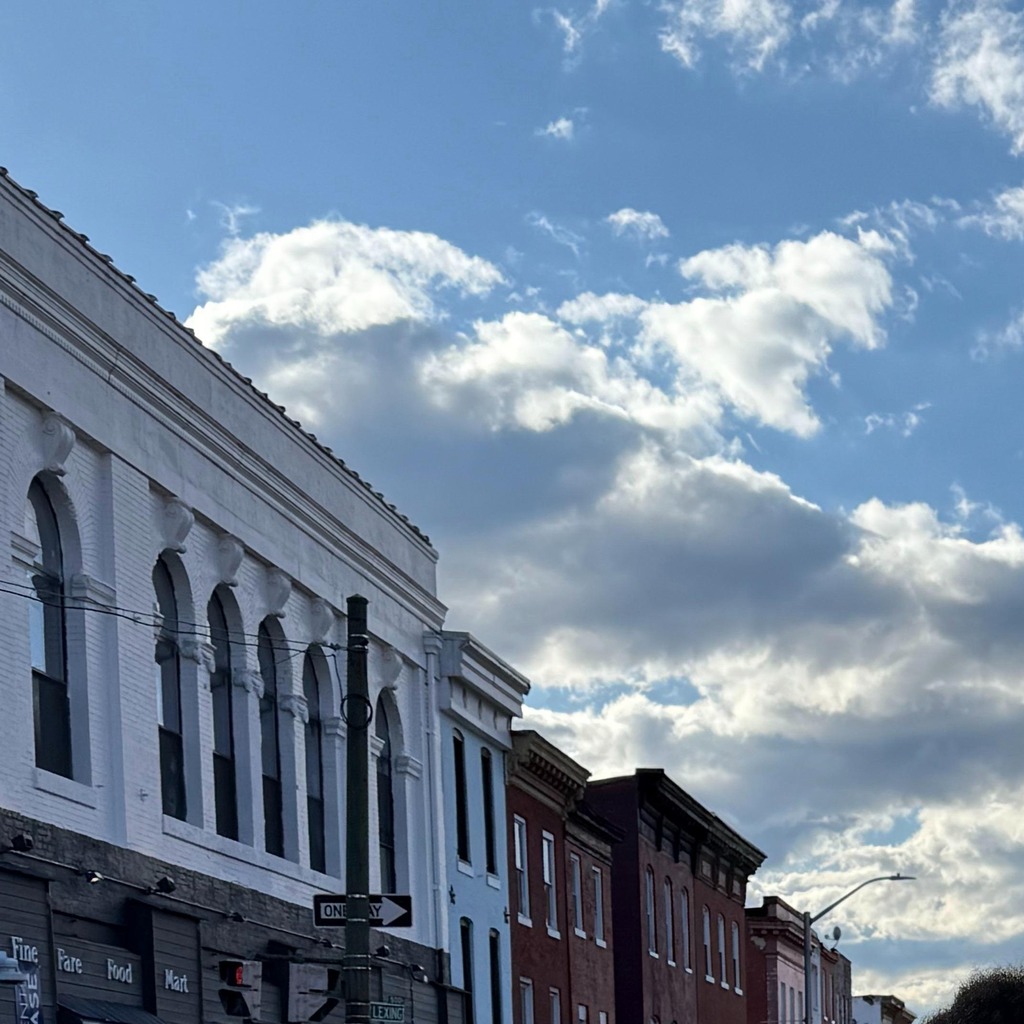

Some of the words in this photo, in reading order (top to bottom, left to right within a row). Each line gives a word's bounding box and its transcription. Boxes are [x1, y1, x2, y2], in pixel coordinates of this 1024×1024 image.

[11, 936, 38, 963] Fine
[57, 948, 82, 974] Fare
[106, 958, 133, 984] Food
[165, 969, 189, 993] Mart
